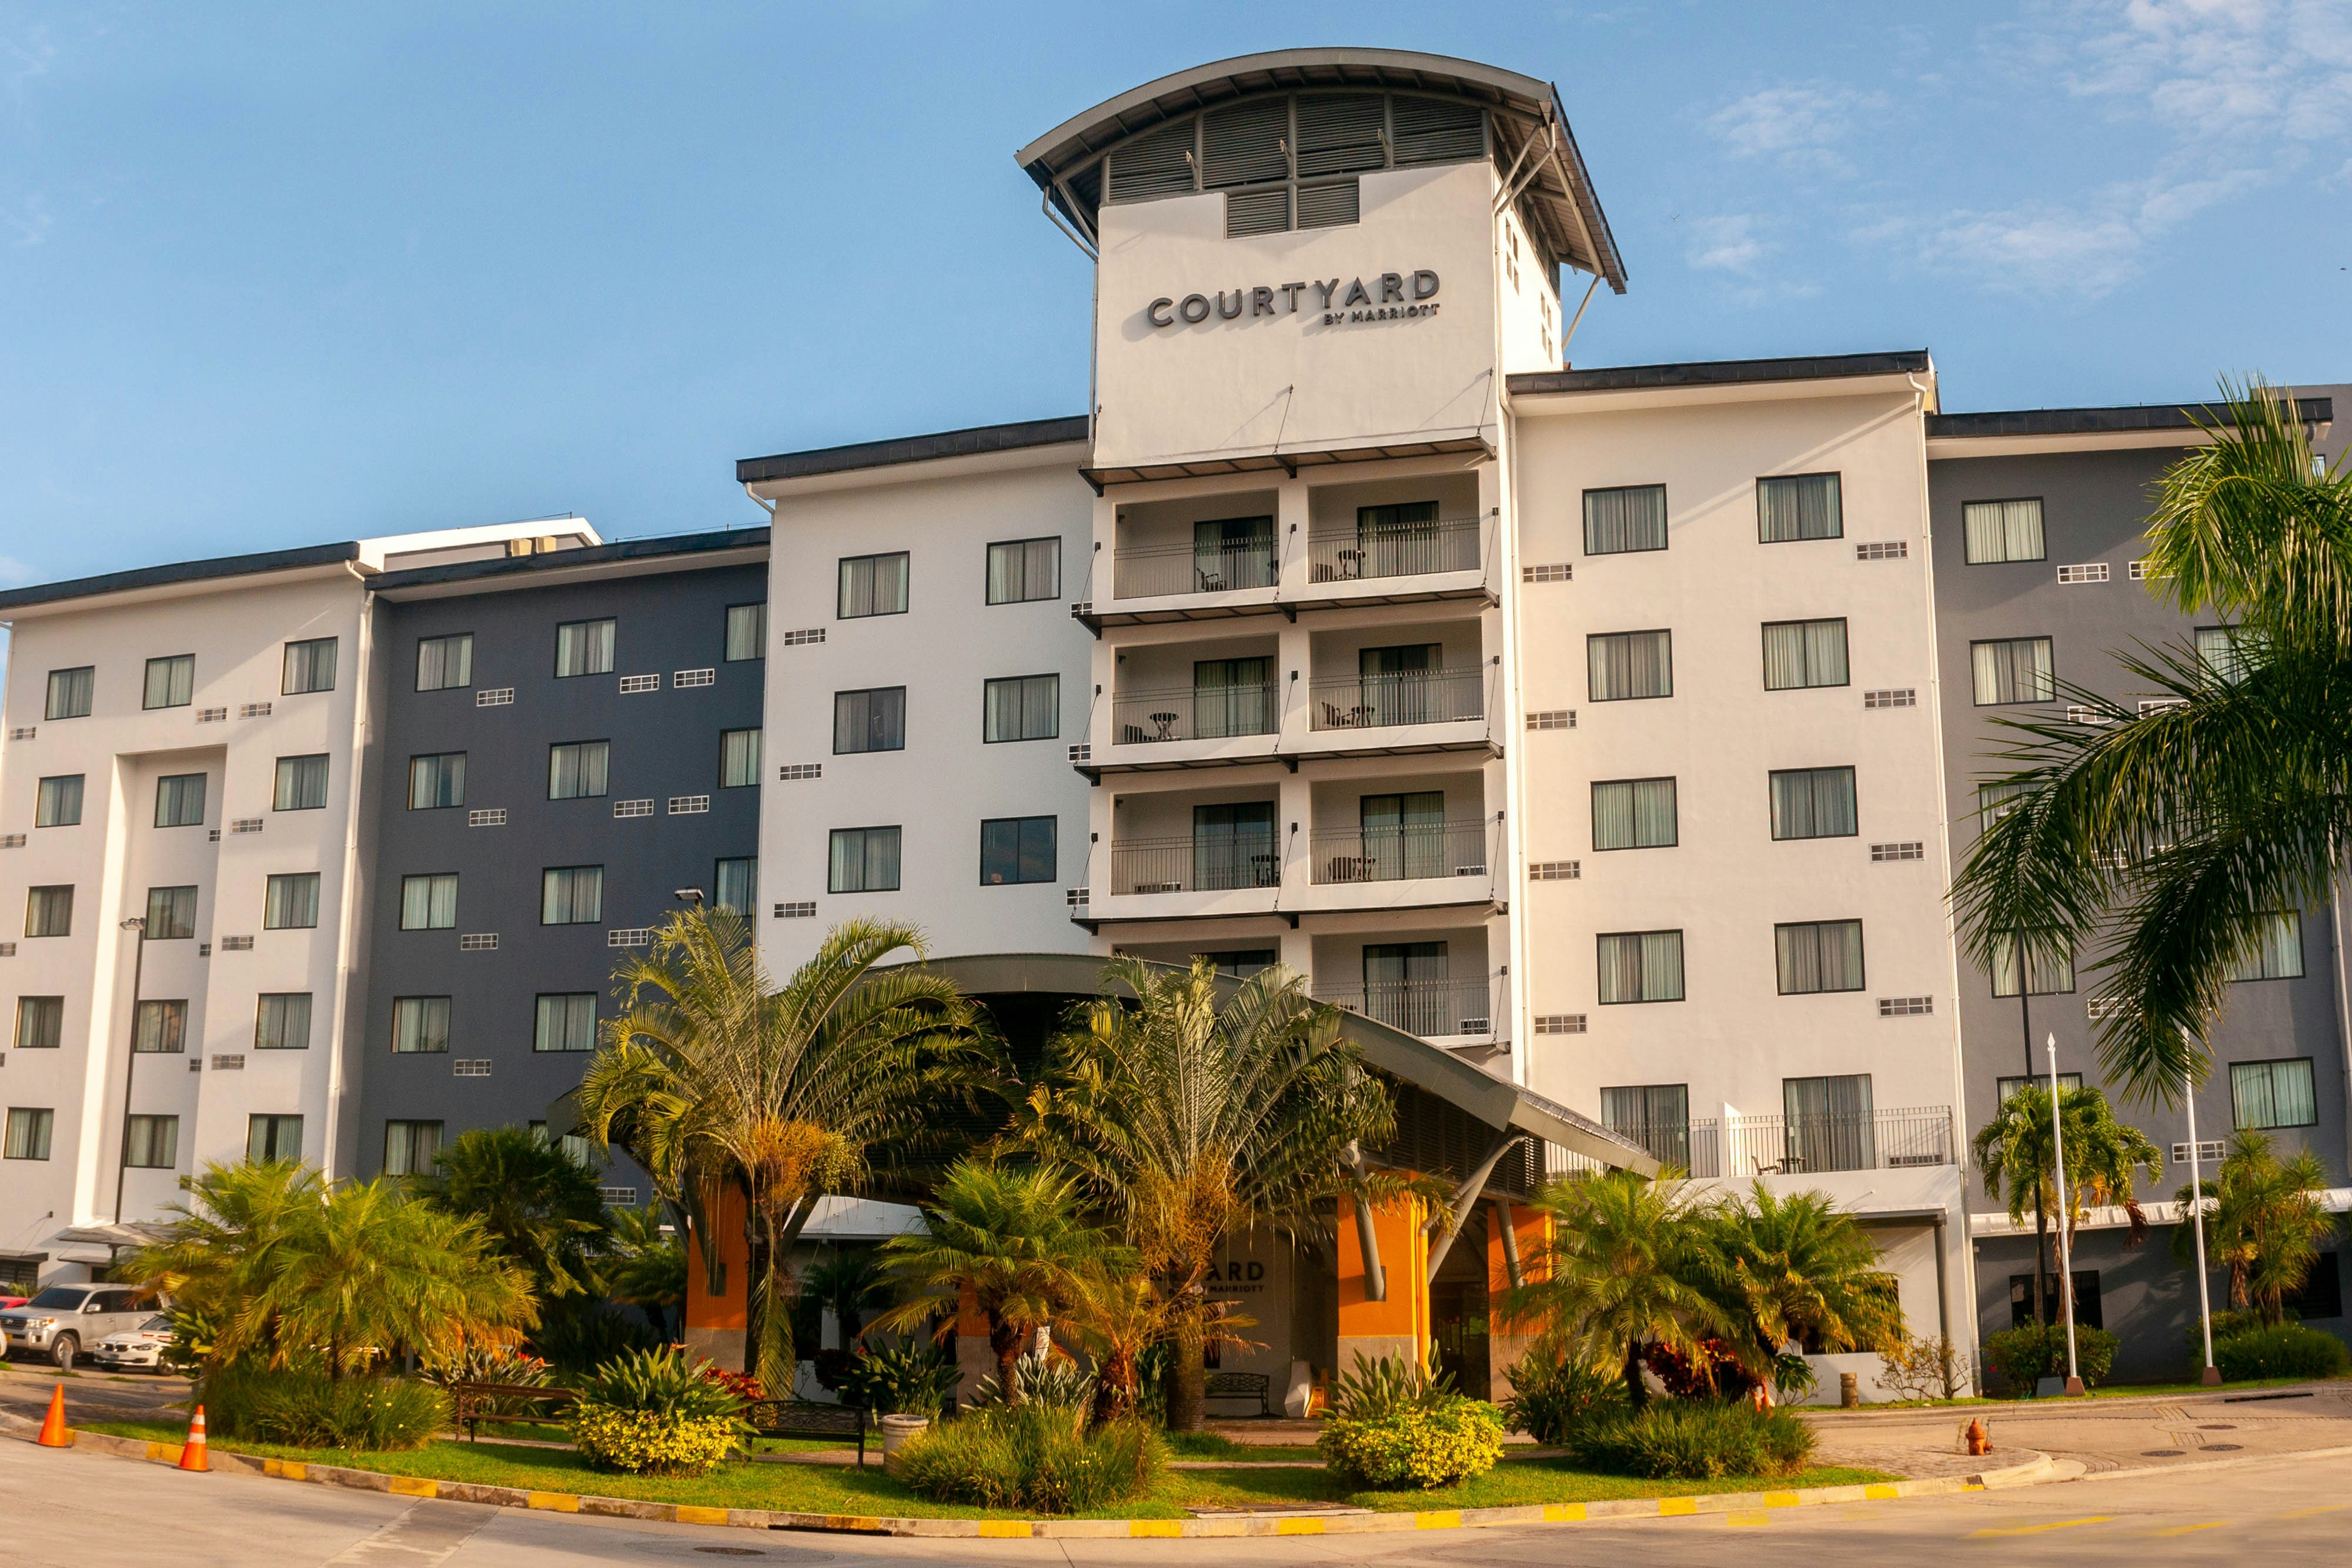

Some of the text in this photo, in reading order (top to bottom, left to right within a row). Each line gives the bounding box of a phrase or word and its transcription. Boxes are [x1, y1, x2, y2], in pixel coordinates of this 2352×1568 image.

[1147, 269, 1440, 327] COURTYARD
[1324, 303, 1440, 325] BY MARRIOTT
